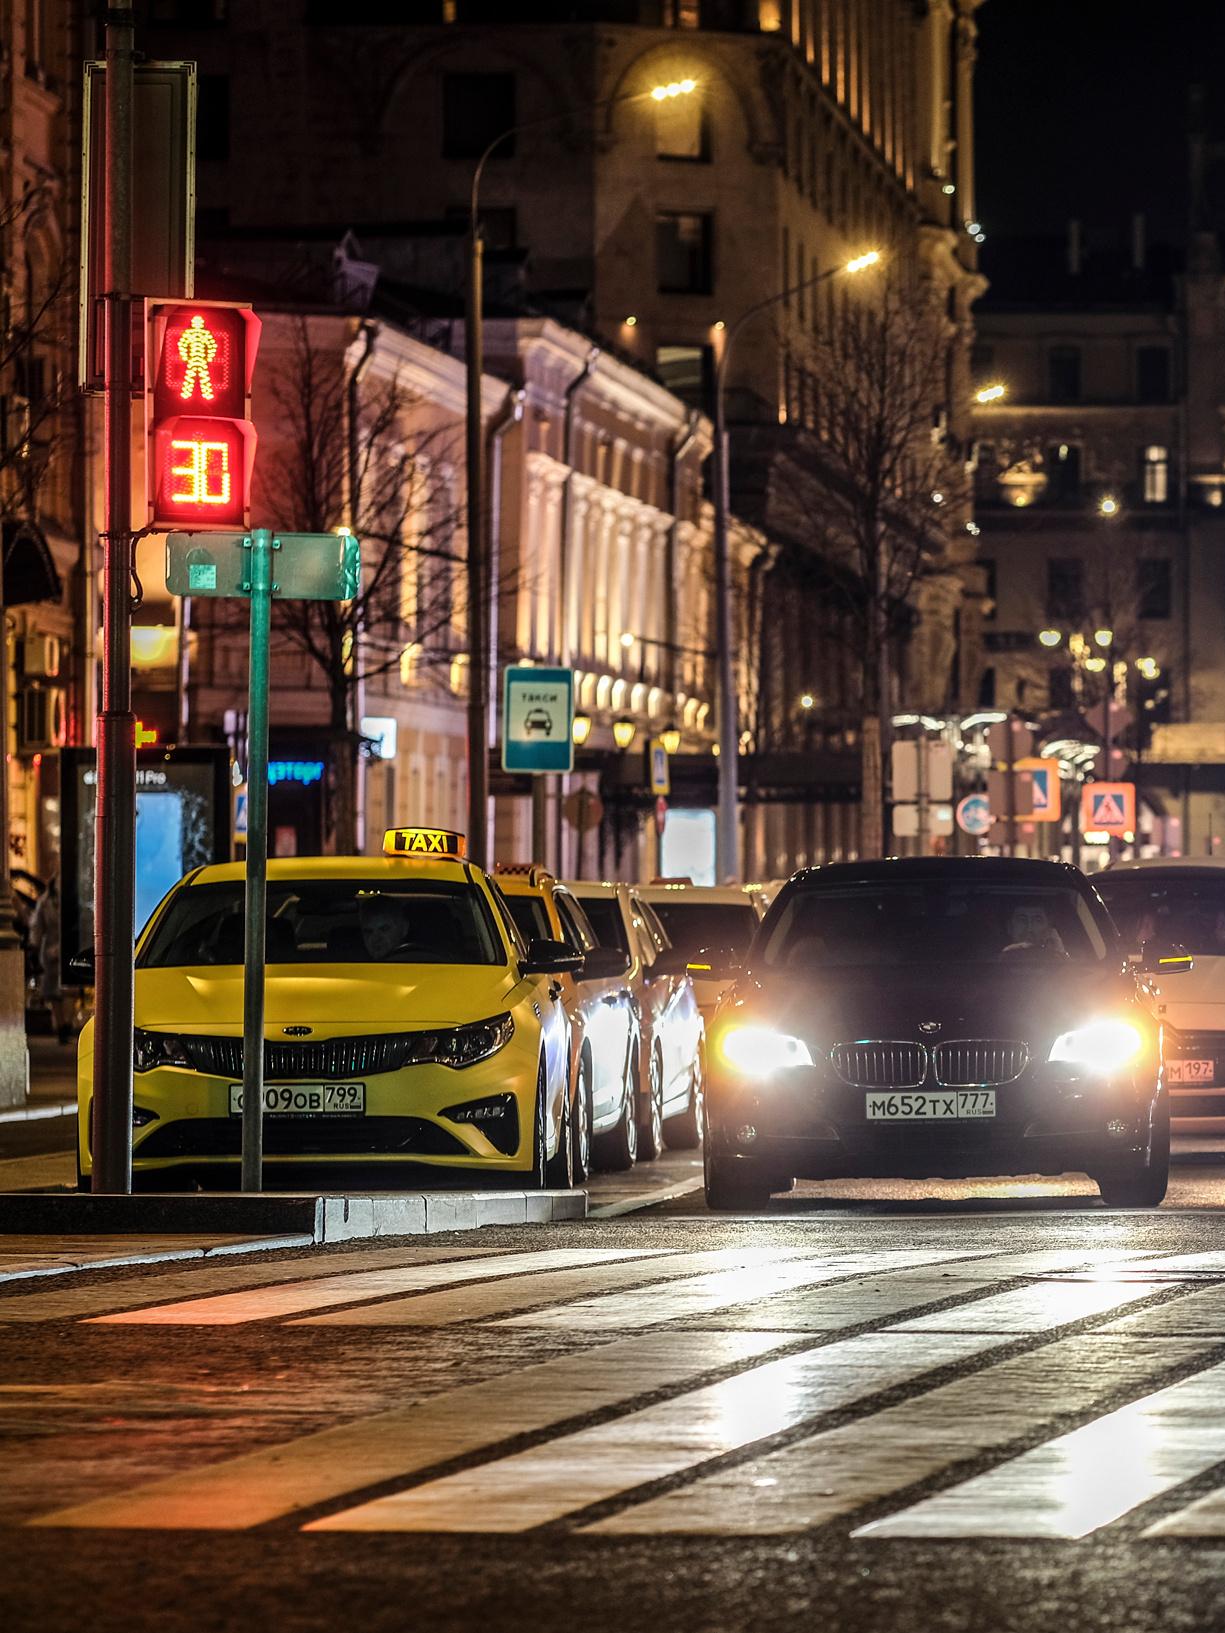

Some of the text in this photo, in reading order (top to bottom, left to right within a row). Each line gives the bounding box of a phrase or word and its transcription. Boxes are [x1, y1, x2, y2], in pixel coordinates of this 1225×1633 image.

[171, 440, 231, 504] 30
[402, 832, 449, 853] TAXI
[1185, 1062, 1209, 1075] 197
[325, 1087, 358, 1103] 799
[872, 1093, 989, 1116] М652ТХ 777
